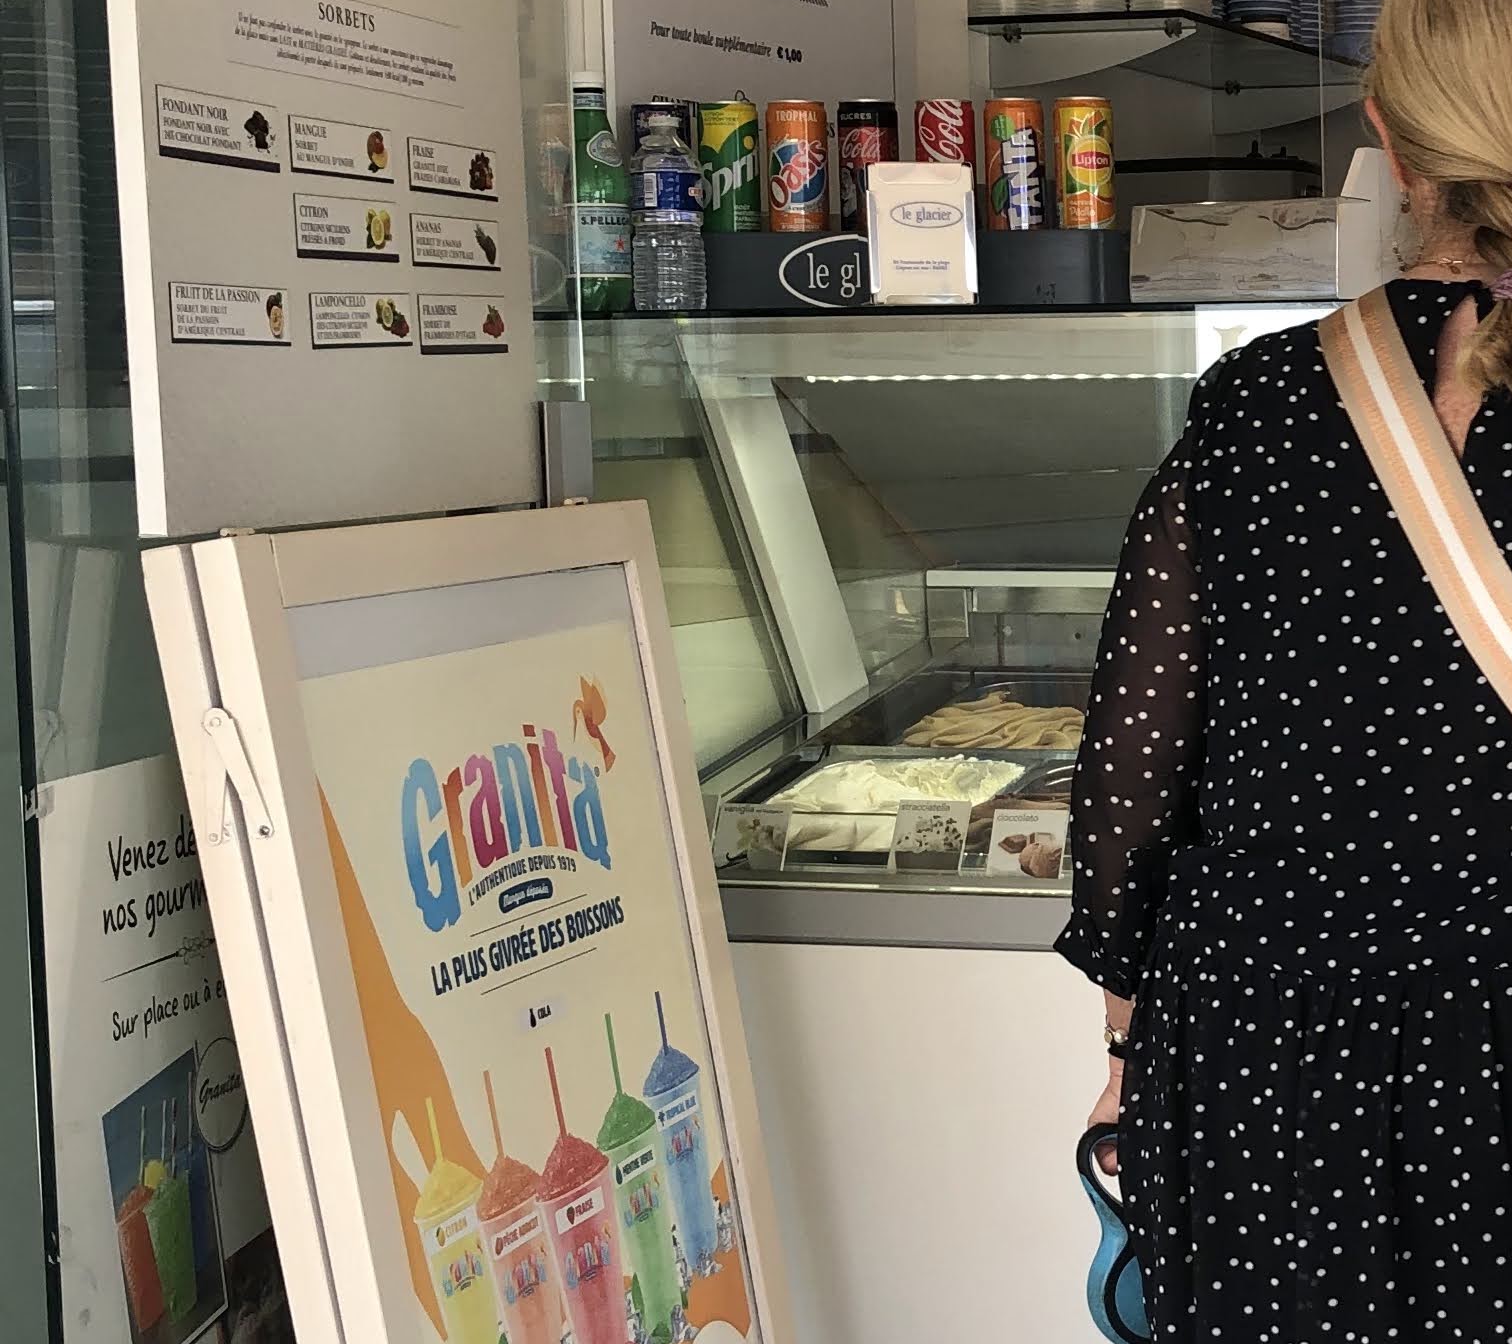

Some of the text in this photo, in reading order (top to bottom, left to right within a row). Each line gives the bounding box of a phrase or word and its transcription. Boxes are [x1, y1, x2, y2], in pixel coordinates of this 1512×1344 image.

[318, 1, 376, 33] SORBETS
[650, 21, 803, 64] Pour toute boule supplémentaire € 1,00
[162, 98, 229, 122] FONDANT NOIR
[294, 122, 327, 139] MANGUE
[412, 144, 435, 158] FRAISE
[1075, 154, 1109, 166] Lipton
[769, 138, 828, 212] Oasis
[1001, 127, 1044, 231] FANTA
[299, 204, 329, 219] CITRON
[901, 207, 952, 223] le glacier
[415, 221, 442, 234] ANANAS
[175, 285, 261, 304] FRUIT DE LA PASSION
[314, 294, 367, 308] LAMPONCELLO
[422, 304, 458, 317] FRAMBOISE
[401, 723, 612, 934] Granita
[107, 834, 170, 882] Venez
[467, 855, 577, 907] L'AUTHENTIQUE DEPUIS 1979
[102, 897, 137, 936] nos
[430, 895, 625, 997] LA PLUS GIVRÉE DES BOISSONS
[112, 1010, 138, 1042] Sur
[142, 994, 179, 1038] place
[182, 988, 201, 1012] ou
[203, 978, 212, 1003] à
[574, 1197, 594, 1217] FRAISE
